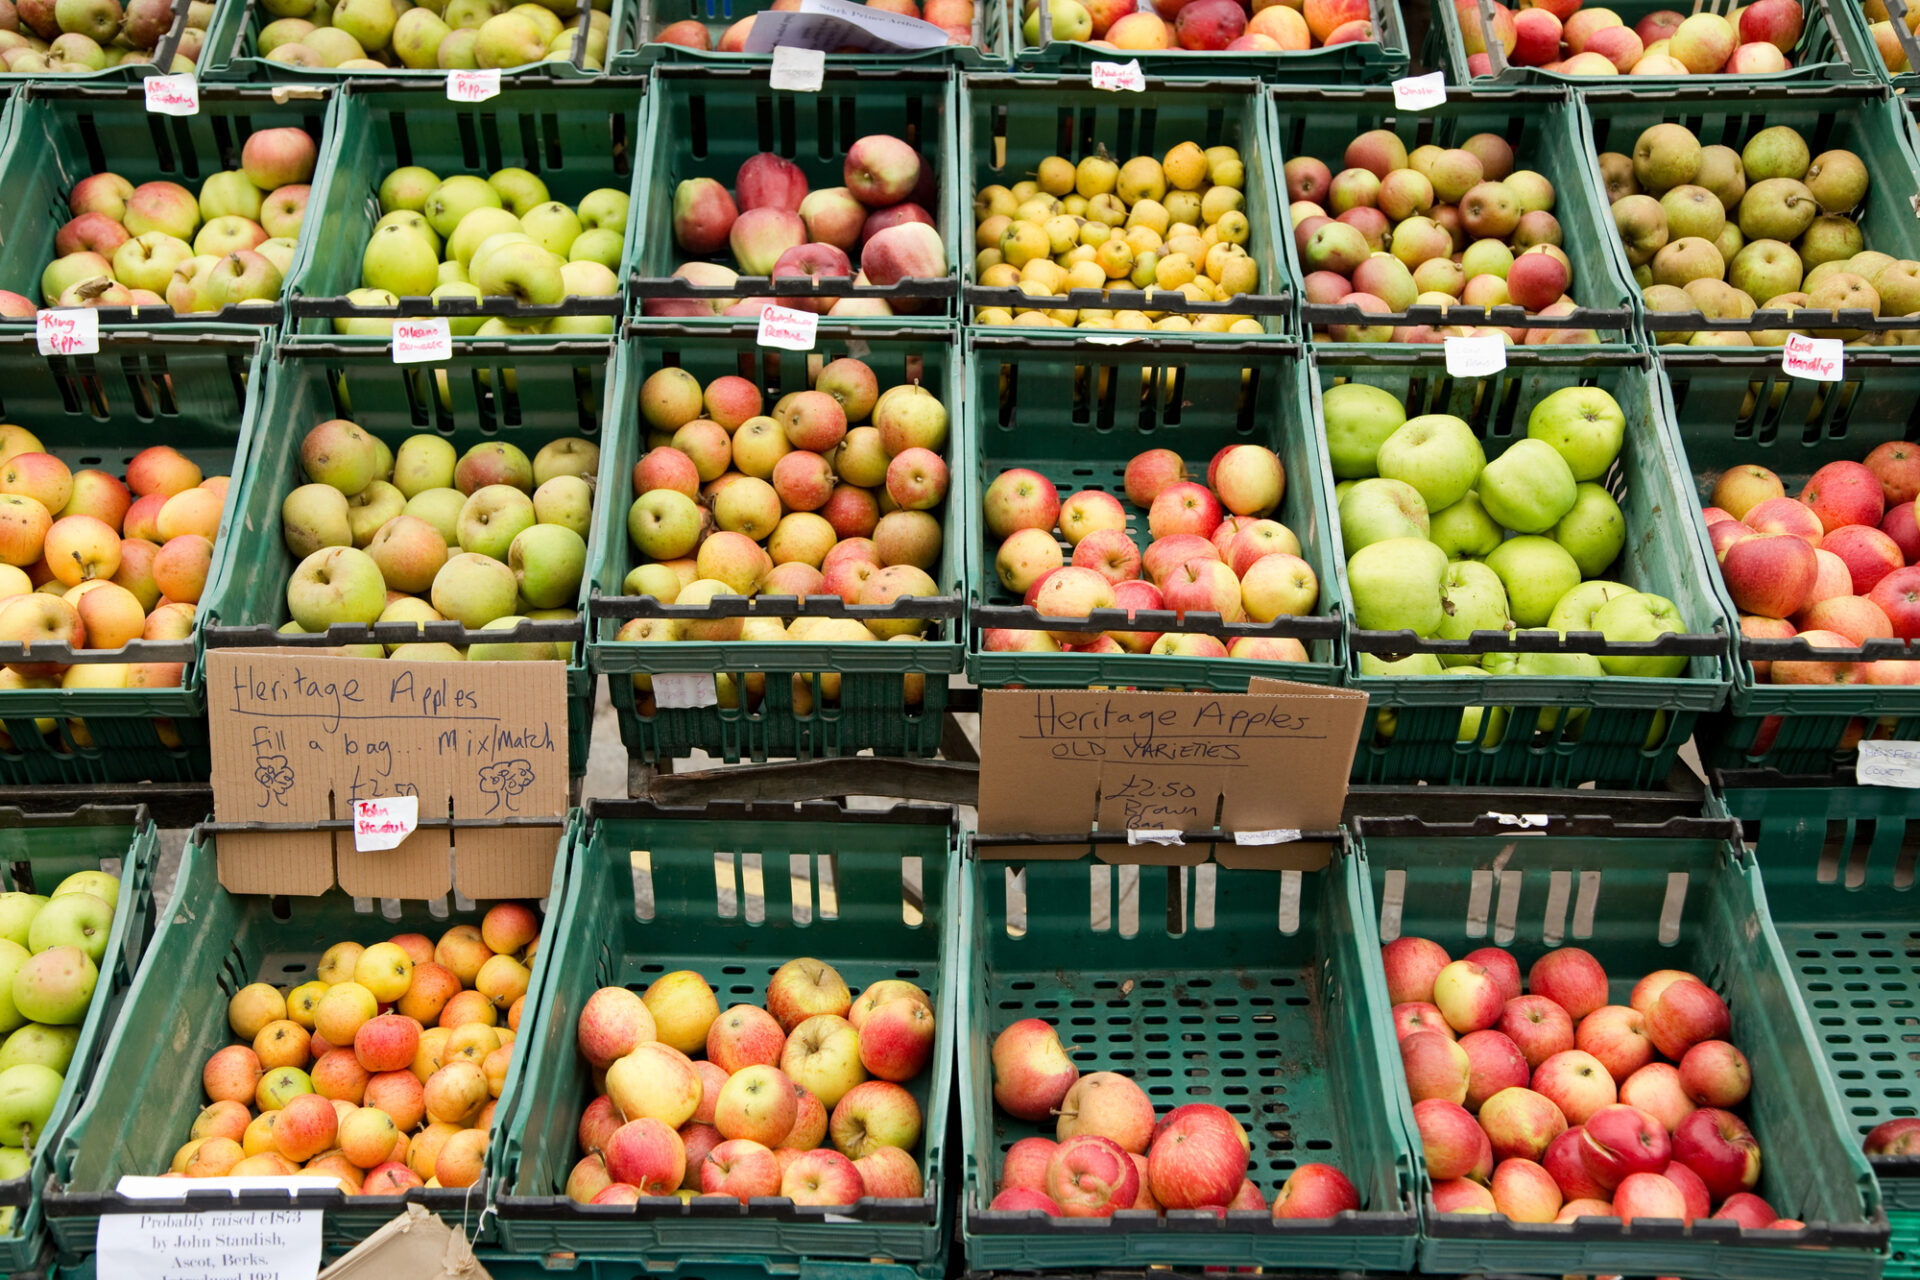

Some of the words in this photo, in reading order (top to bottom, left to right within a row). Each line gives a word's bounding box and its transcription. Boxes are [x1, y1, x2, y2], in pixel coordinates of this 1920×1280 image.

[40, 313, 75, 334] King
[234, 664, 364, 734] Heritage
[390, 670, 478, 716] Apples
[1034, 694, 1177, 746] Heritage
[1193, 700, 1309, 737] Apples
[308, 739, 325, 752] a
[1052, 741, 1106, 758] OLD
[358, 802, 389, 817] John
[1123, 798, 1197, 817] Brown
[140, 1214, 205, 1231] Probably
[211, 1211, 256, 1227] raised
[152, 1235, 167, 1253] by
[173, 1234, 212, 1249] John
[215, 1231, 286, 1248] Standish,
[172, 1256, 216, 1269] Ascot,
[222, 1253, 269, 1267] Berks.
